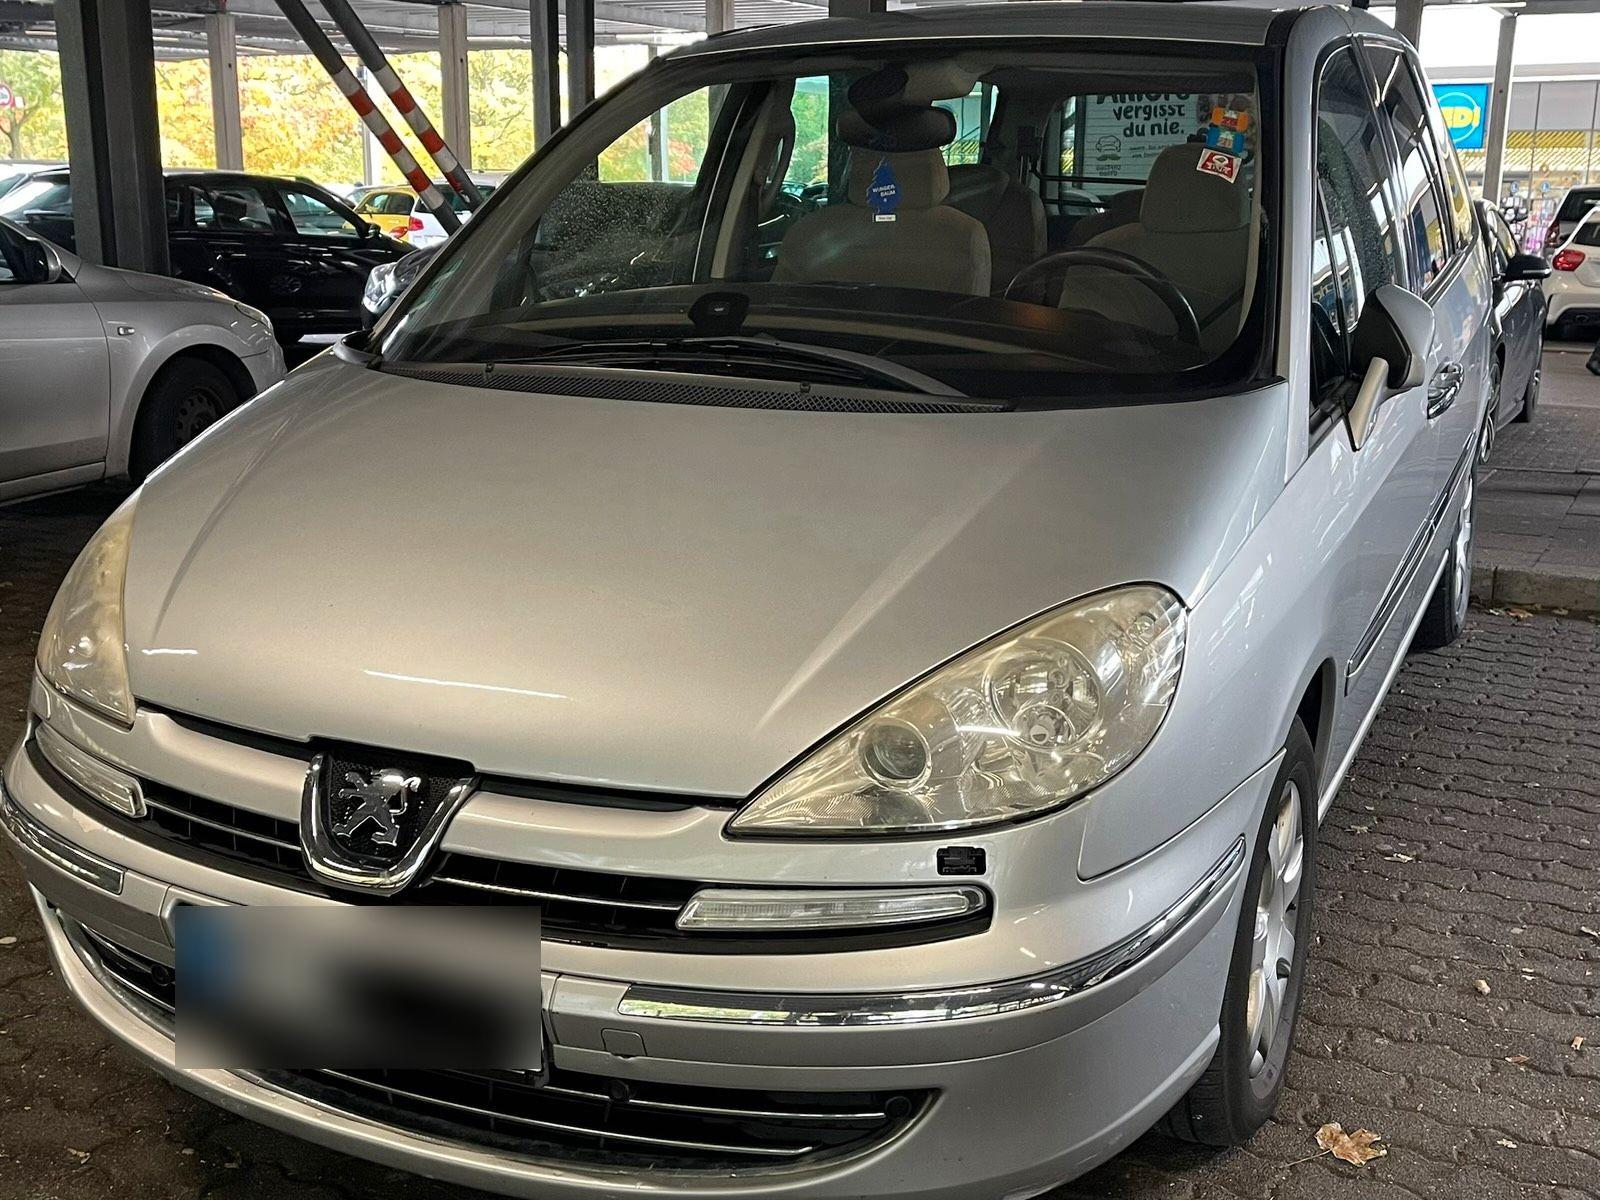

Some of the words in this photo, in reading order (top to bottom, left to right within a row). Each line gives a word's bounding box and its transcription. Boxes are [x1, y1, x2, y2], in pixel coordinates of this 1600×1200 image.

[1113, 104, 1185, 121] vergisst
[1123, 121, 1145, 138] du
[1150, 118, 1185, 136] nie.
